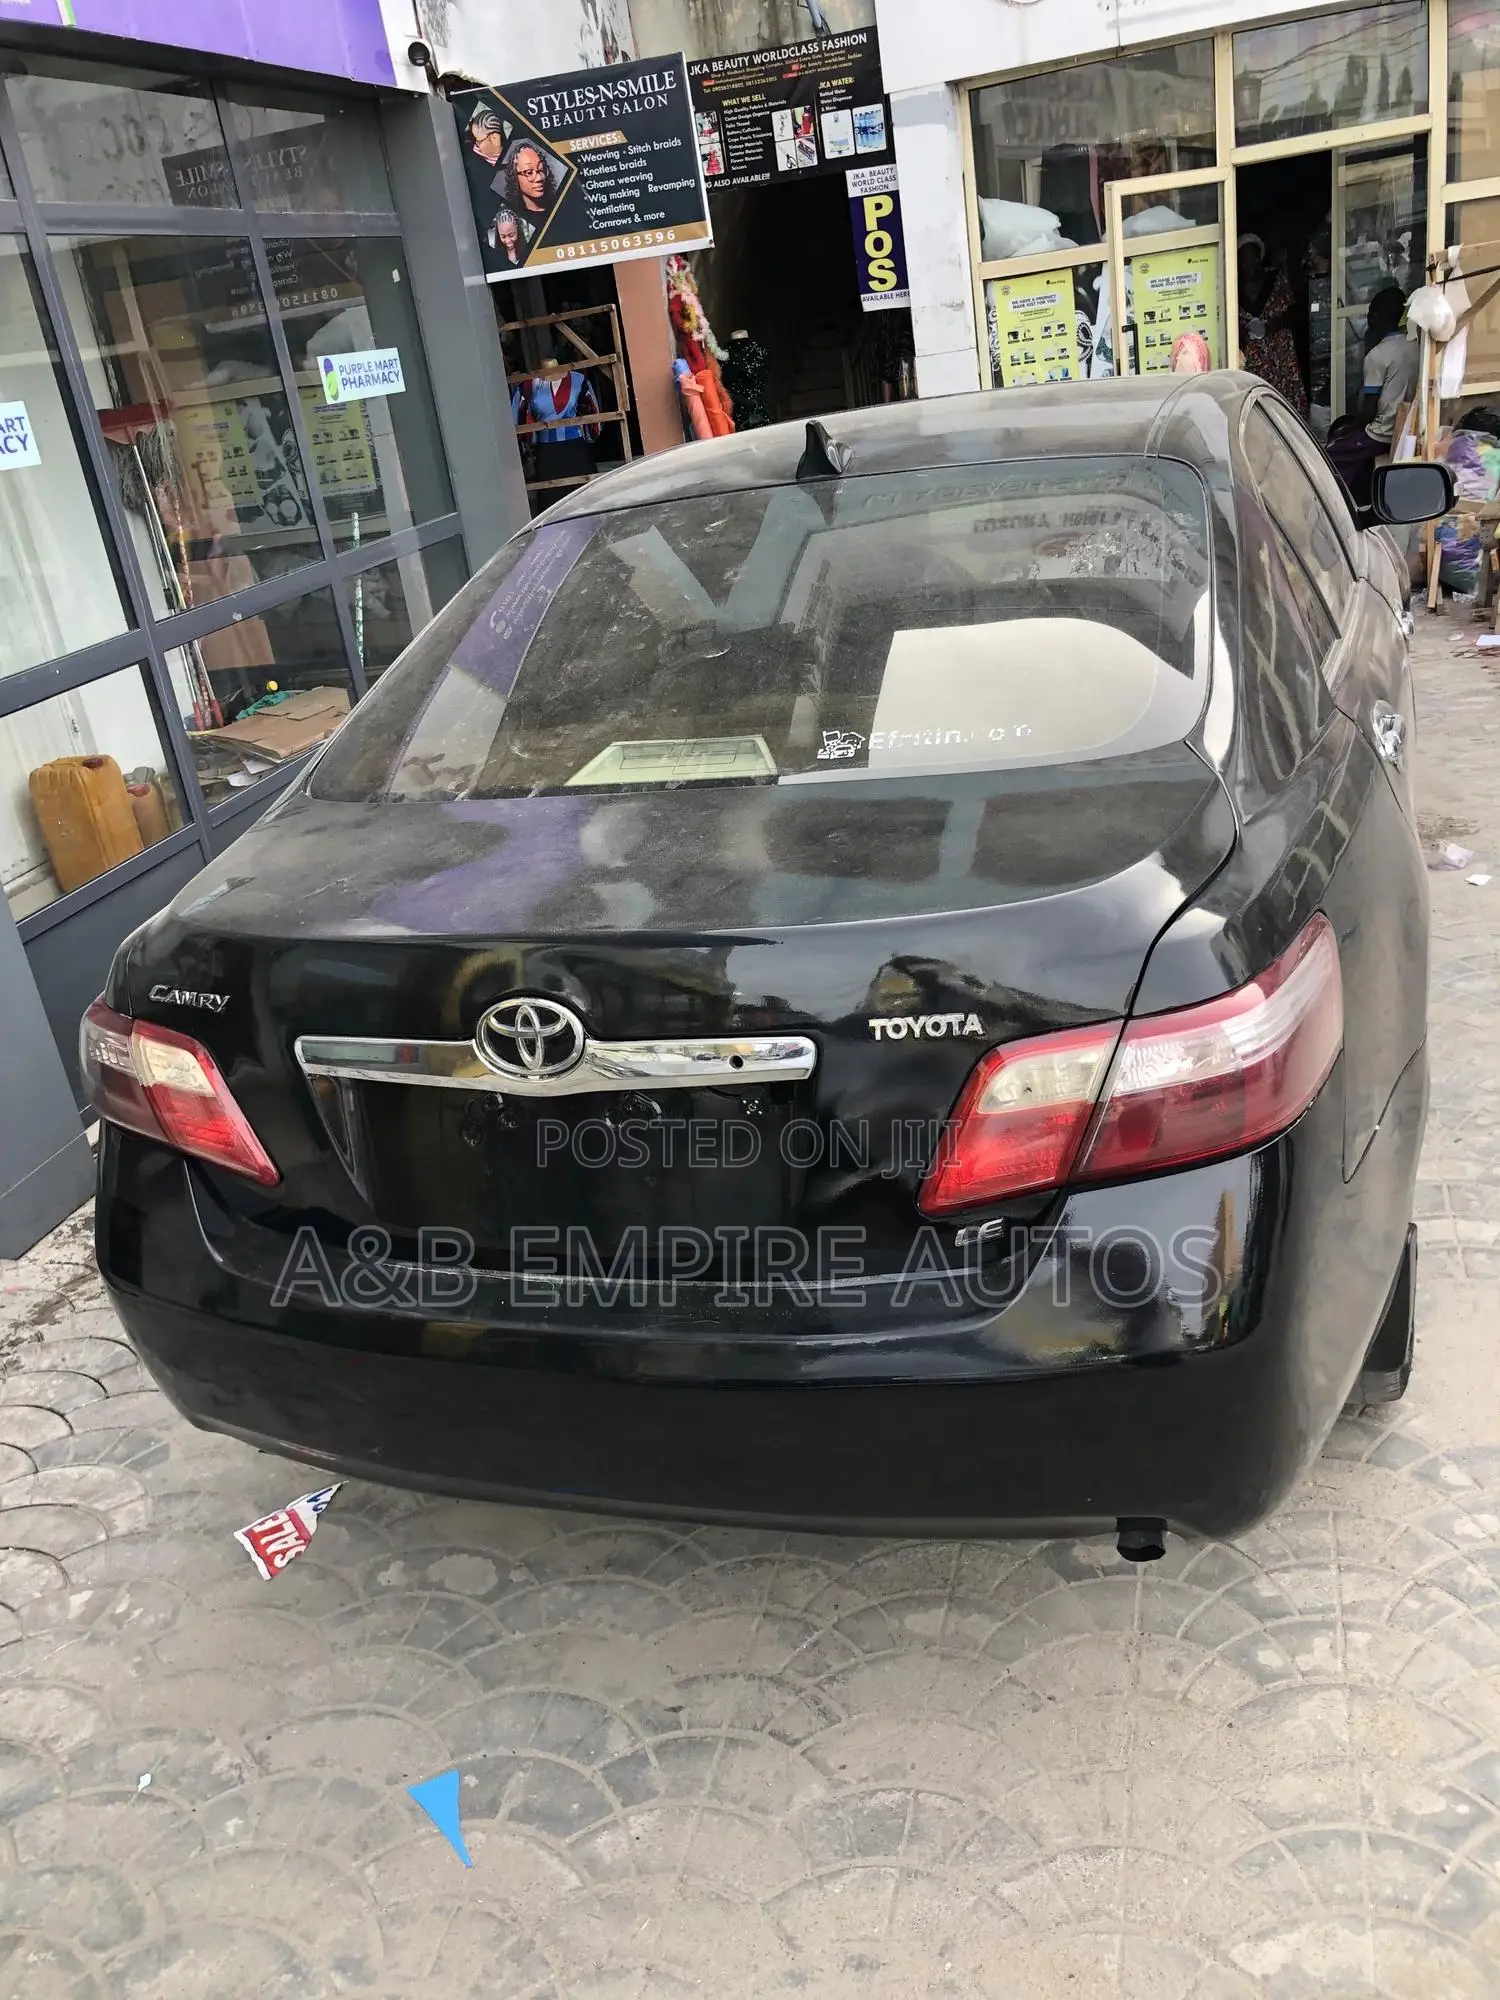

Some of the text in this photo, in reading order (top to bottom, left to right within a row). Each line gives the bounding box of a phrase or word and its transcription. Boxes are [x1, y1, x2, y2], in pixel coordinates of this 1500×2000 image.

[690, 32, 867, 76] JKA BEAUTY WORLDCLASS FASHION
[527, 70, 677, 116] STYLES-N-SMILE
[721, 93, 766, 107] WHAT WE SELL
[540, 93, 669, 130] BEAUTY SALON
[569, 133, 622, 151] SERVICES:
[580, 137, 682, 164] Weaving Stitch braids
[582, 158, 647, 178] Knotless braids
[869, 167, 894, 178] BEAUTY
[585, 171, 654, 191] Ghana weaving
[714, 179, 731, 188] ALSO
[851, 175, 897, 188] WORLD CLASS
[860, 184, 889, 194] FASHION
[588, 177, 696, 206] Wig making Revamping
[589, 201, 636, 217] Ventilating
[592, 211, 666, 231] Cornrows & more
[863, 194, 898, 292] POS
[862, 289, 910, 303] AVAILABLE HERE
[338, 358, 398, 377] PURPLE MART
[341, 370, 400, 390] PHARMACY
[149, 984, 231, 1013] CAMRY
[868, 1011, 984, 1042] TOYOTA
